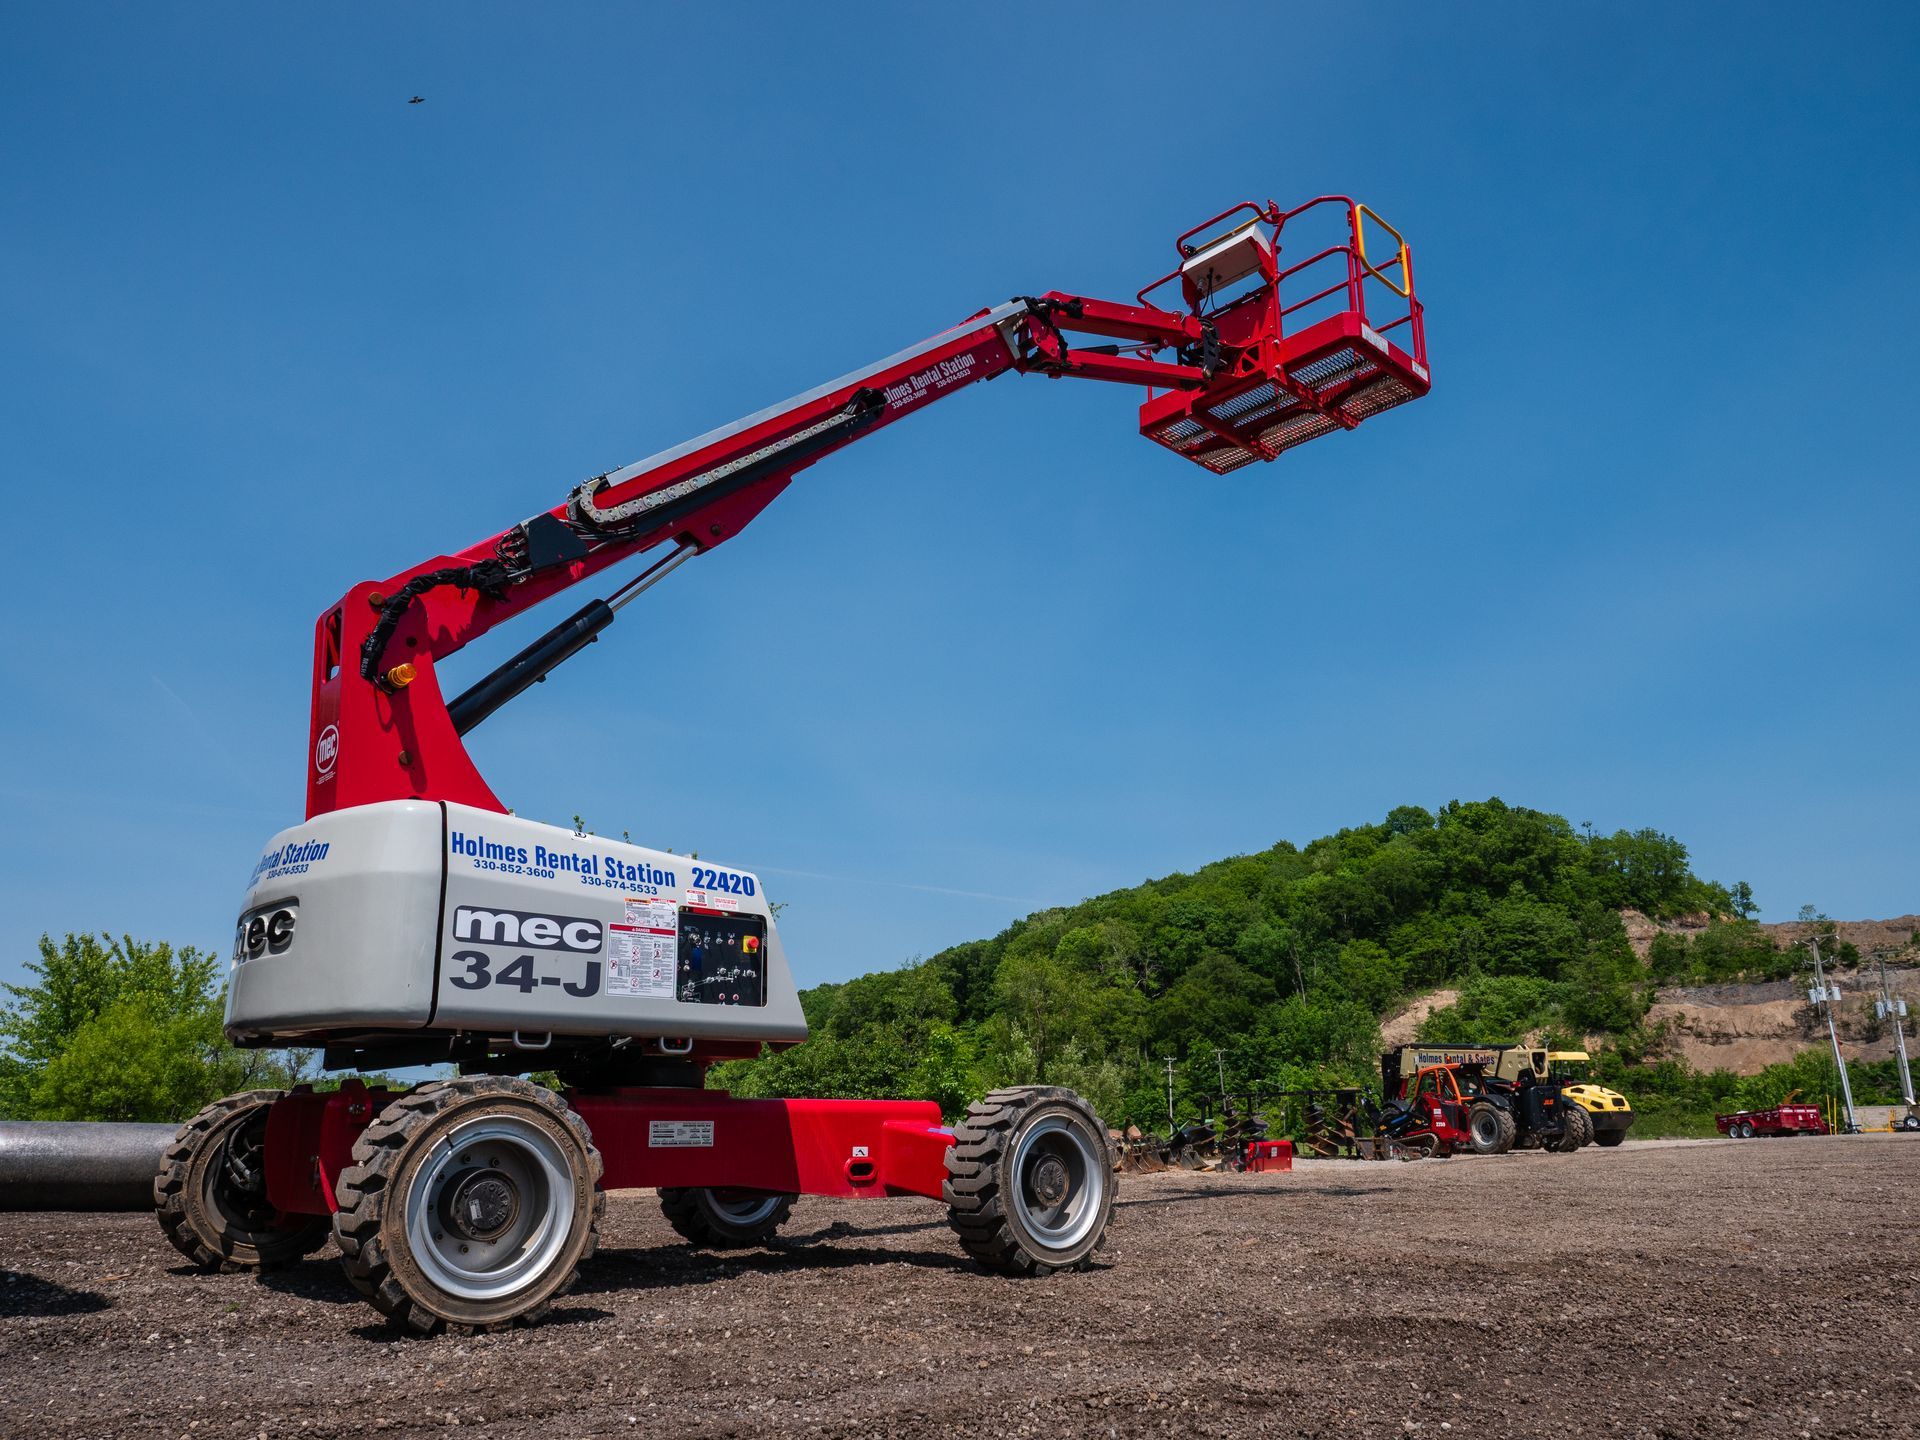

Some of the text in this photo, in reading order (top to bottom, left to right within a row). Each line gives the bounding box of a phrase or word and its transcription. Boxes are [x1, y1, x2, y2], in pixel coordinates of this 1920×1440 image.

[883, 353, 976, 404] olmes Rental Station
[319, 733, 336, 764] mec
[282, 839, 330, 866] Station
[451, 831, 756, 897] Holmes Rental Station 22420
[473, 859, 658, 895] 330-852-3600 330-674-5533
[455, 909, 601, 950] mec
[449, 950, 601, 998] 34-J
[1418, 1052, 1442, 1064] Holmes
[1444, 1053, 1466, 1064] Rntal
[1475, 1053, 1495, 1065] Sales
